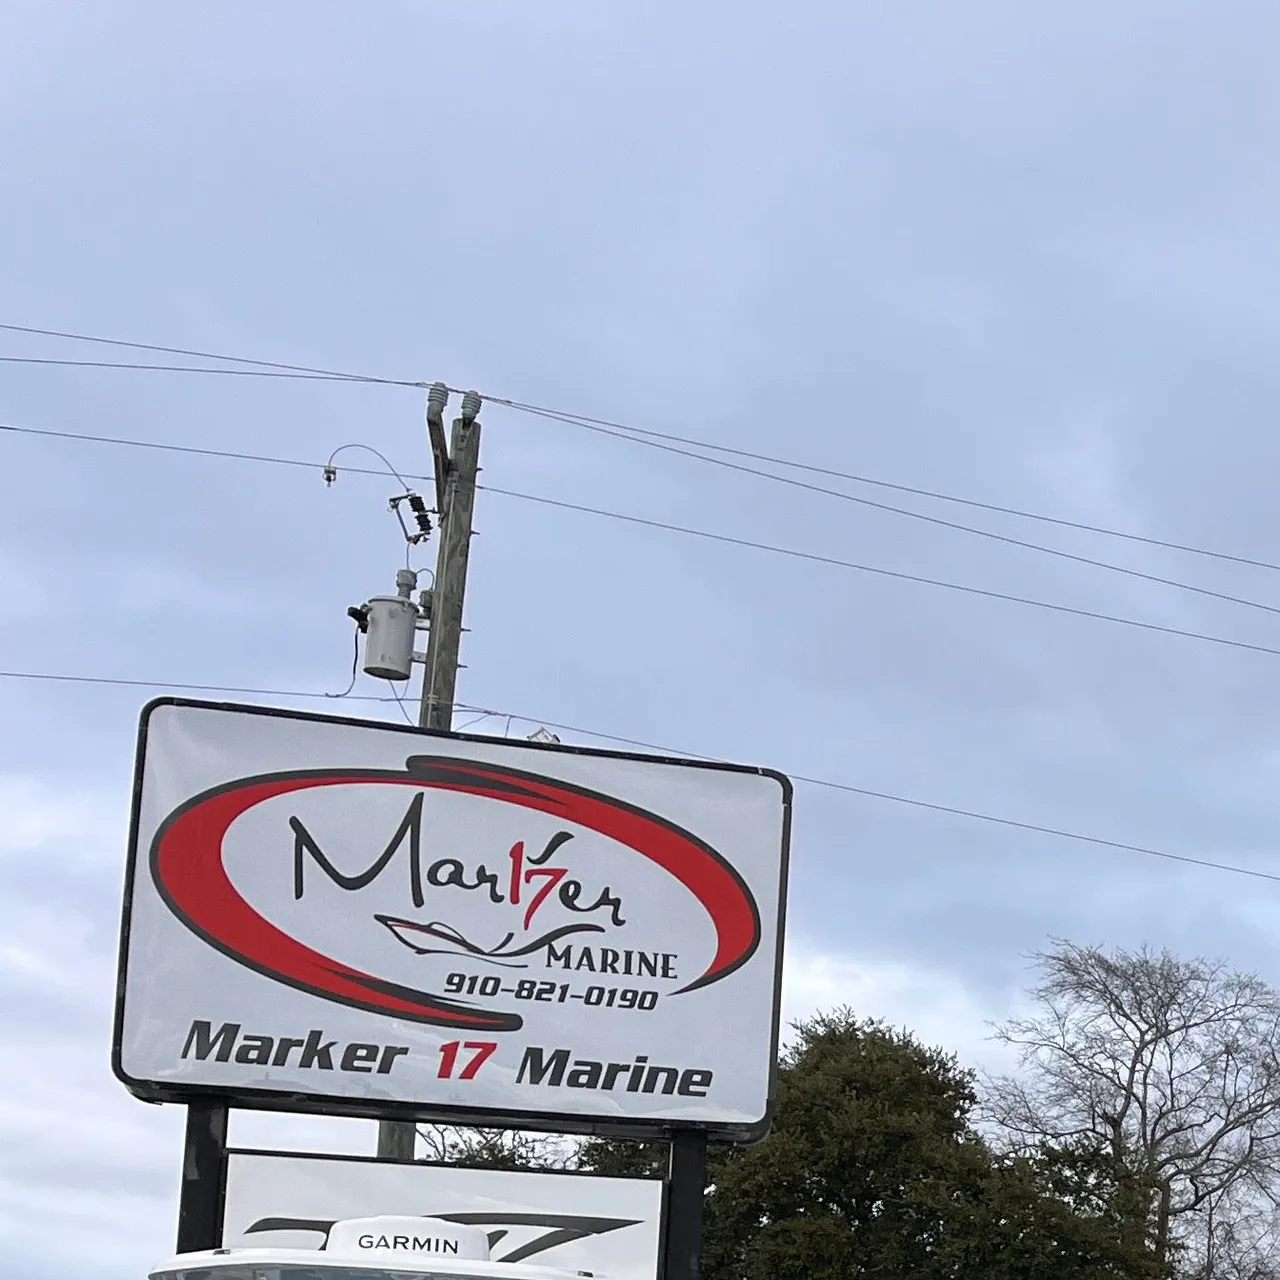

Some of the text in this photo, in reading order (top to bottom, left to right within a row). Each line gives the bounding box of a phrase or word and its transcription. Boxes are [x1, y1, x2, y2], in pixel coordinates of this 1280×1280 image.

[545, 943, 679, 981] MARINE
[443, 973, 660, 1011] 910-821-0190
[180, 1020, 714, 1098] Marker 17 Marine
[358, 1234, 458, 1254] GARMIN
